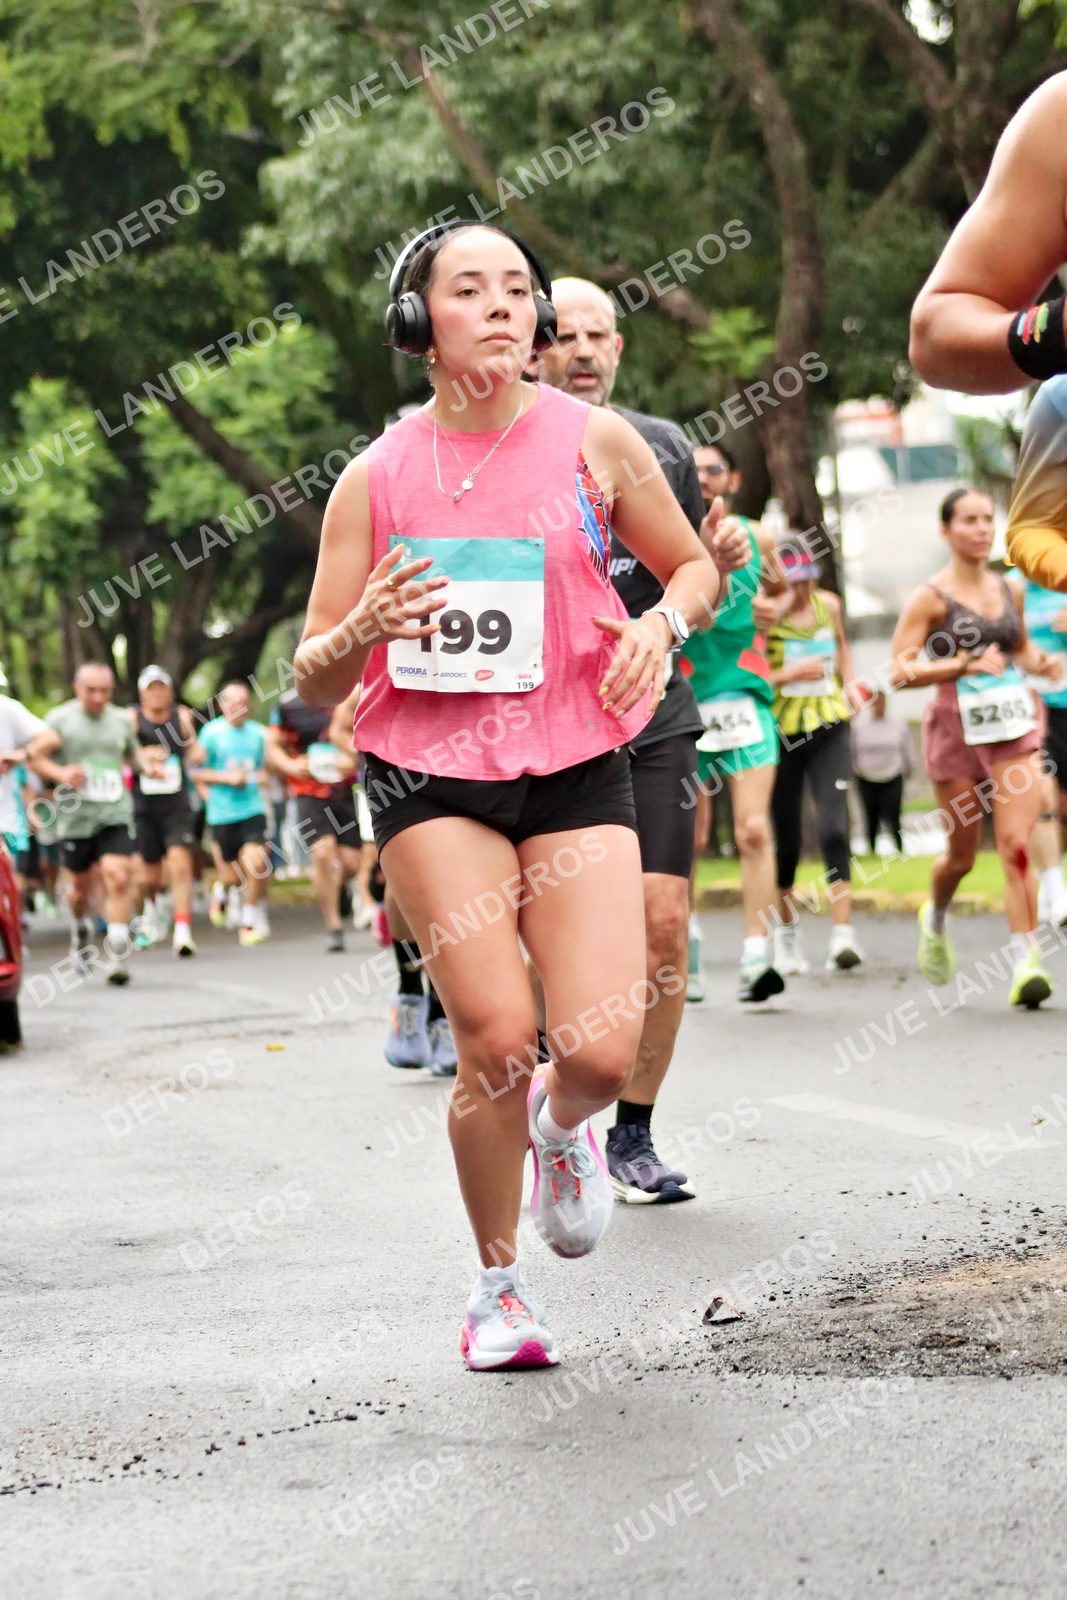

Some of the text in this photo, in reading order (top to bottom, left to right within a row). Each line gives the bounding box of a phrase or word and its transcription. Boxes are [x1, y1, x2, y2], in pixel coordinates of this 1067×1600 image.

[420, 609, 512, 655] 199
[396, 666, 427, 675] PERDURA
[517, 681, 534, 690] 199
[969, 699, 1027, 726] 5265
